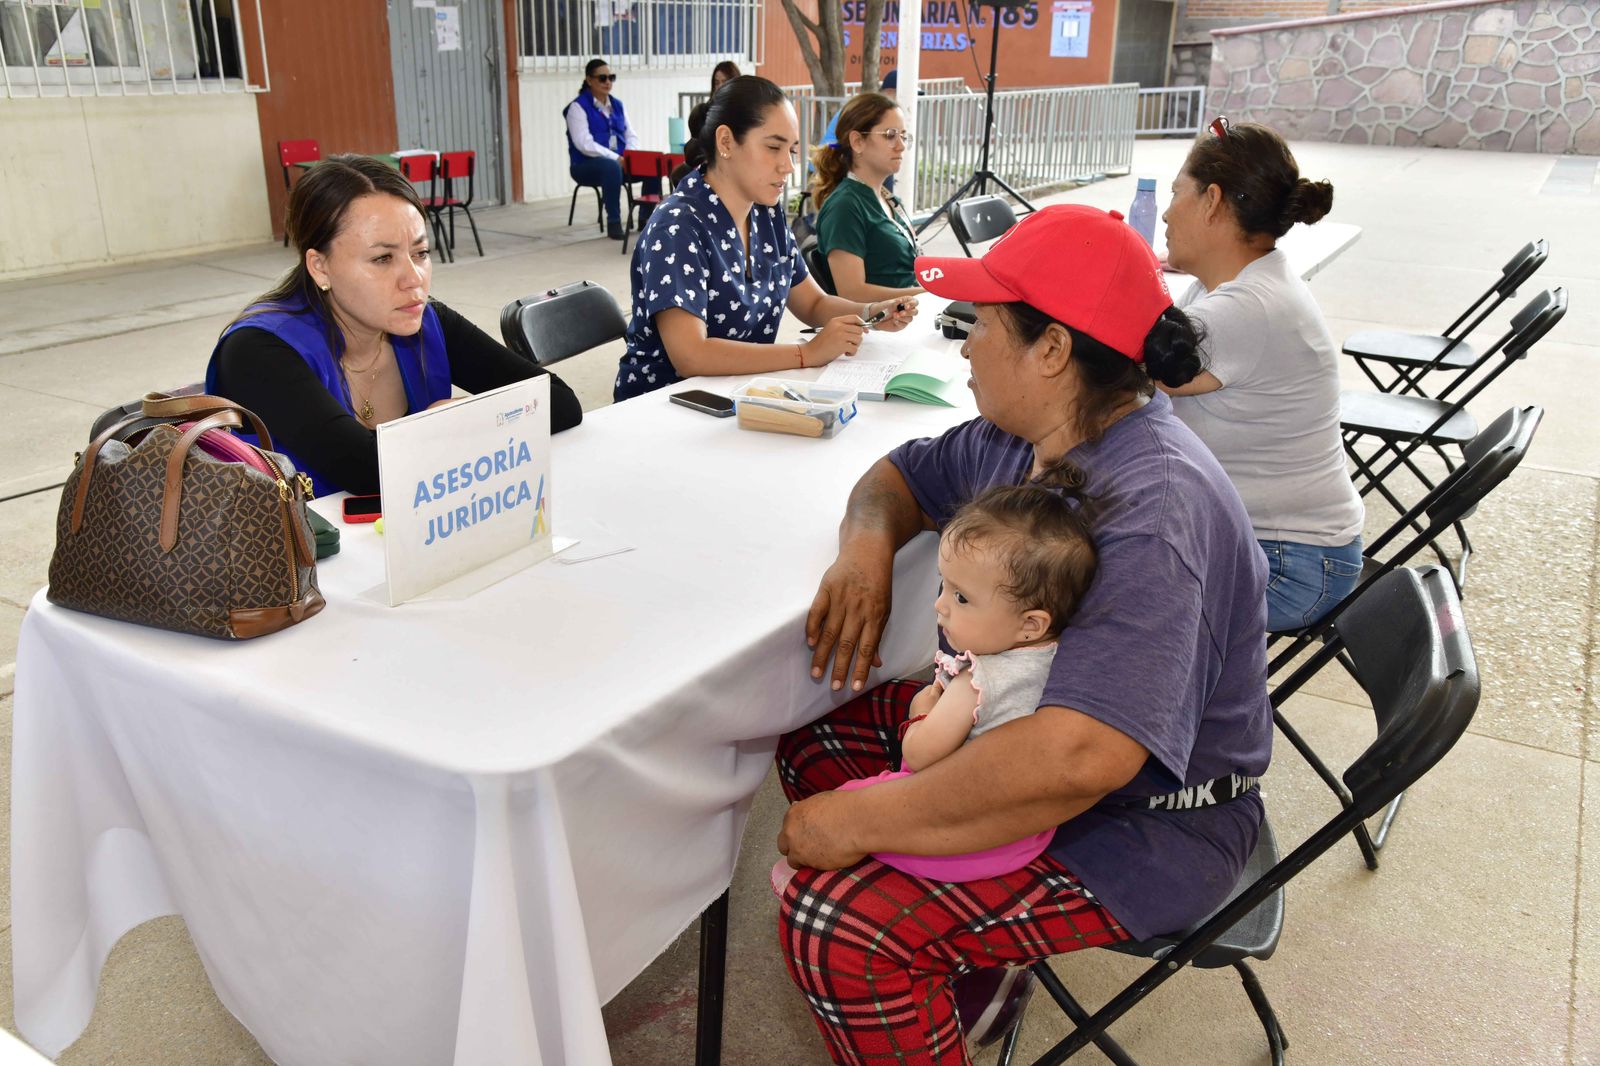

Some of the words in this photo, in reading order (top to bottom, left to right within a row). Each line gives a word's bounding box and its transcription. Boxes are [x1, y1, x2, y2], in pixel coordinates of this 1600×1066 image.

[413, 437, 532, 509] ASESORÍA
[424, 480, 532, 546] JURÍDICA
[1148, 778, 1217, 810] PINK
